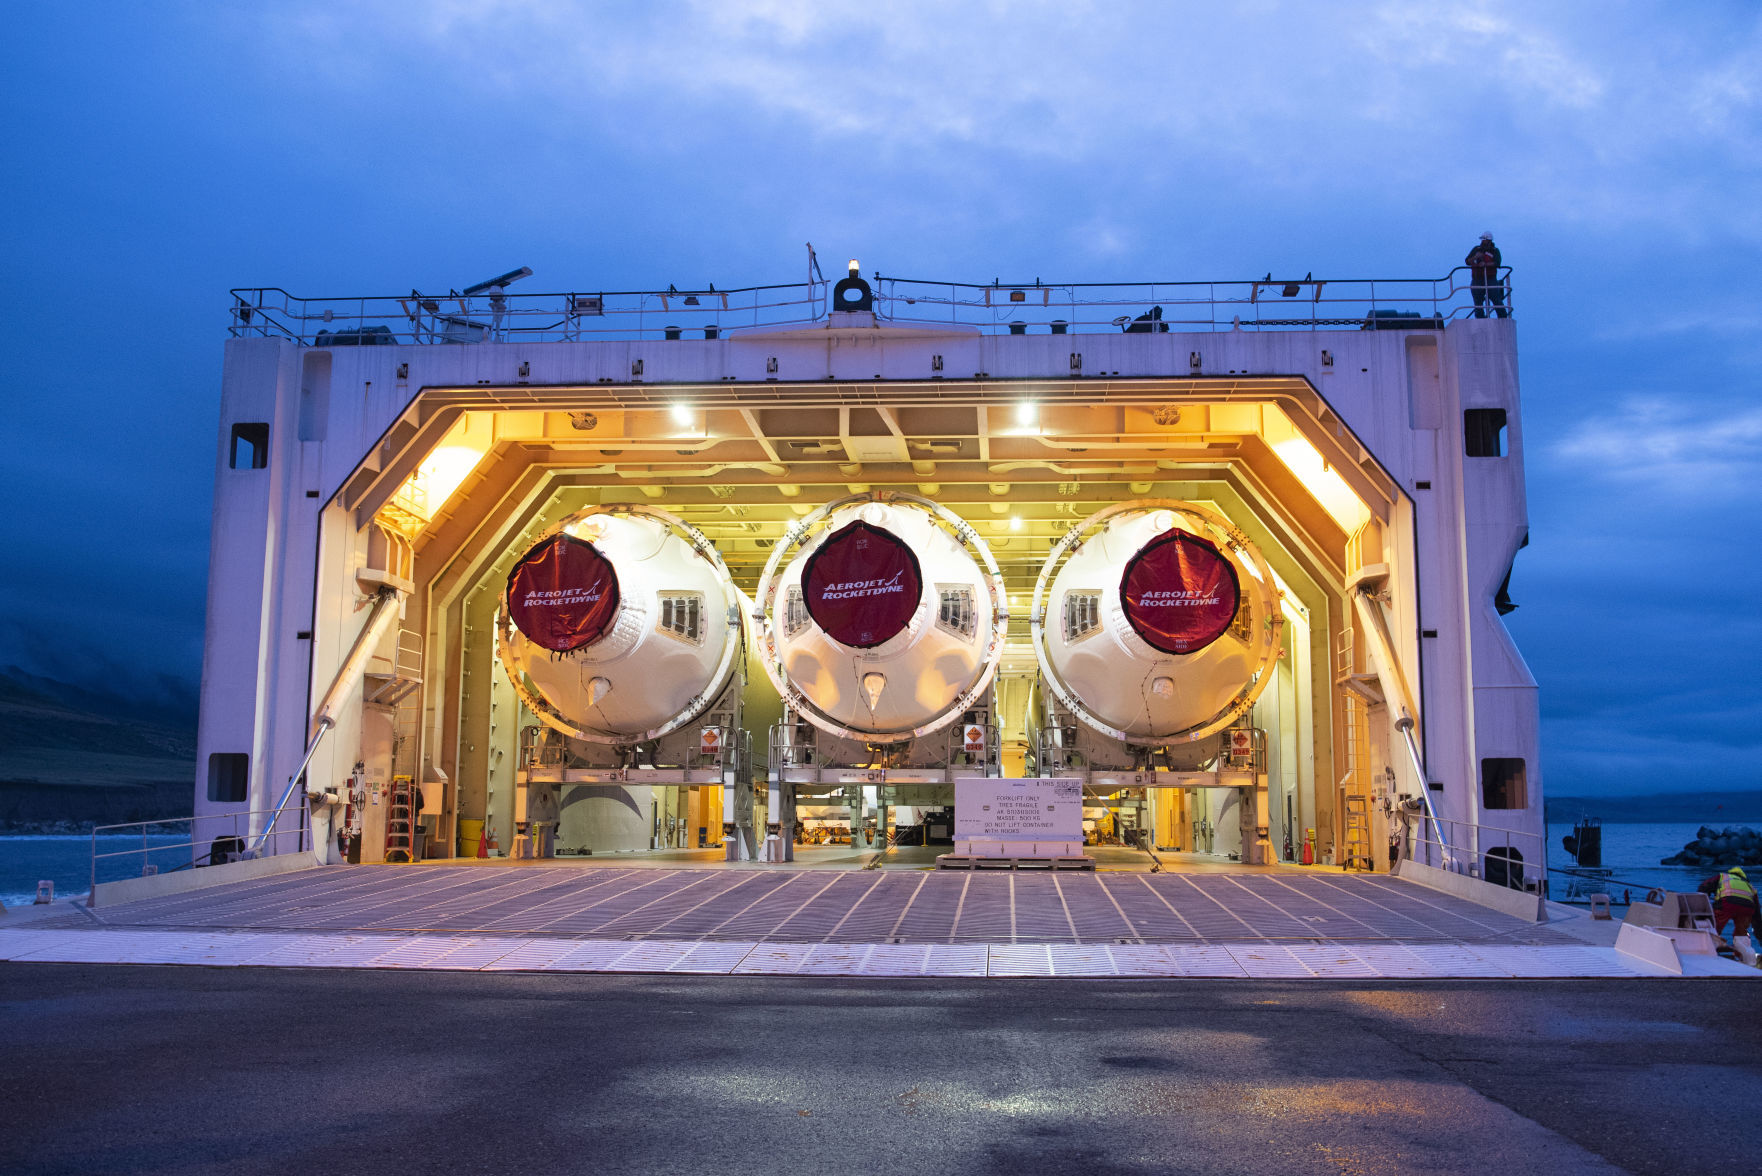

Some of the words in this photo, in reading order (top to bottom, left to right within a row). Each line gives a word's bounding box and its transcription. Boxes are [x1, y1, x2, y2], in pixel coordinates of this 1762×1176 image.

[823, 578, 886, 592] AEROJET
[524, 588, 583, 599] AEROJET
[822, 585, 904, 600] ROCKETDYNE
[1141, 590, 1203, 599] AEROJET
[523, 594, 601, 607] ROCKETDYNE
[1139, 597, 1220, 607] ROCKETDYNE
